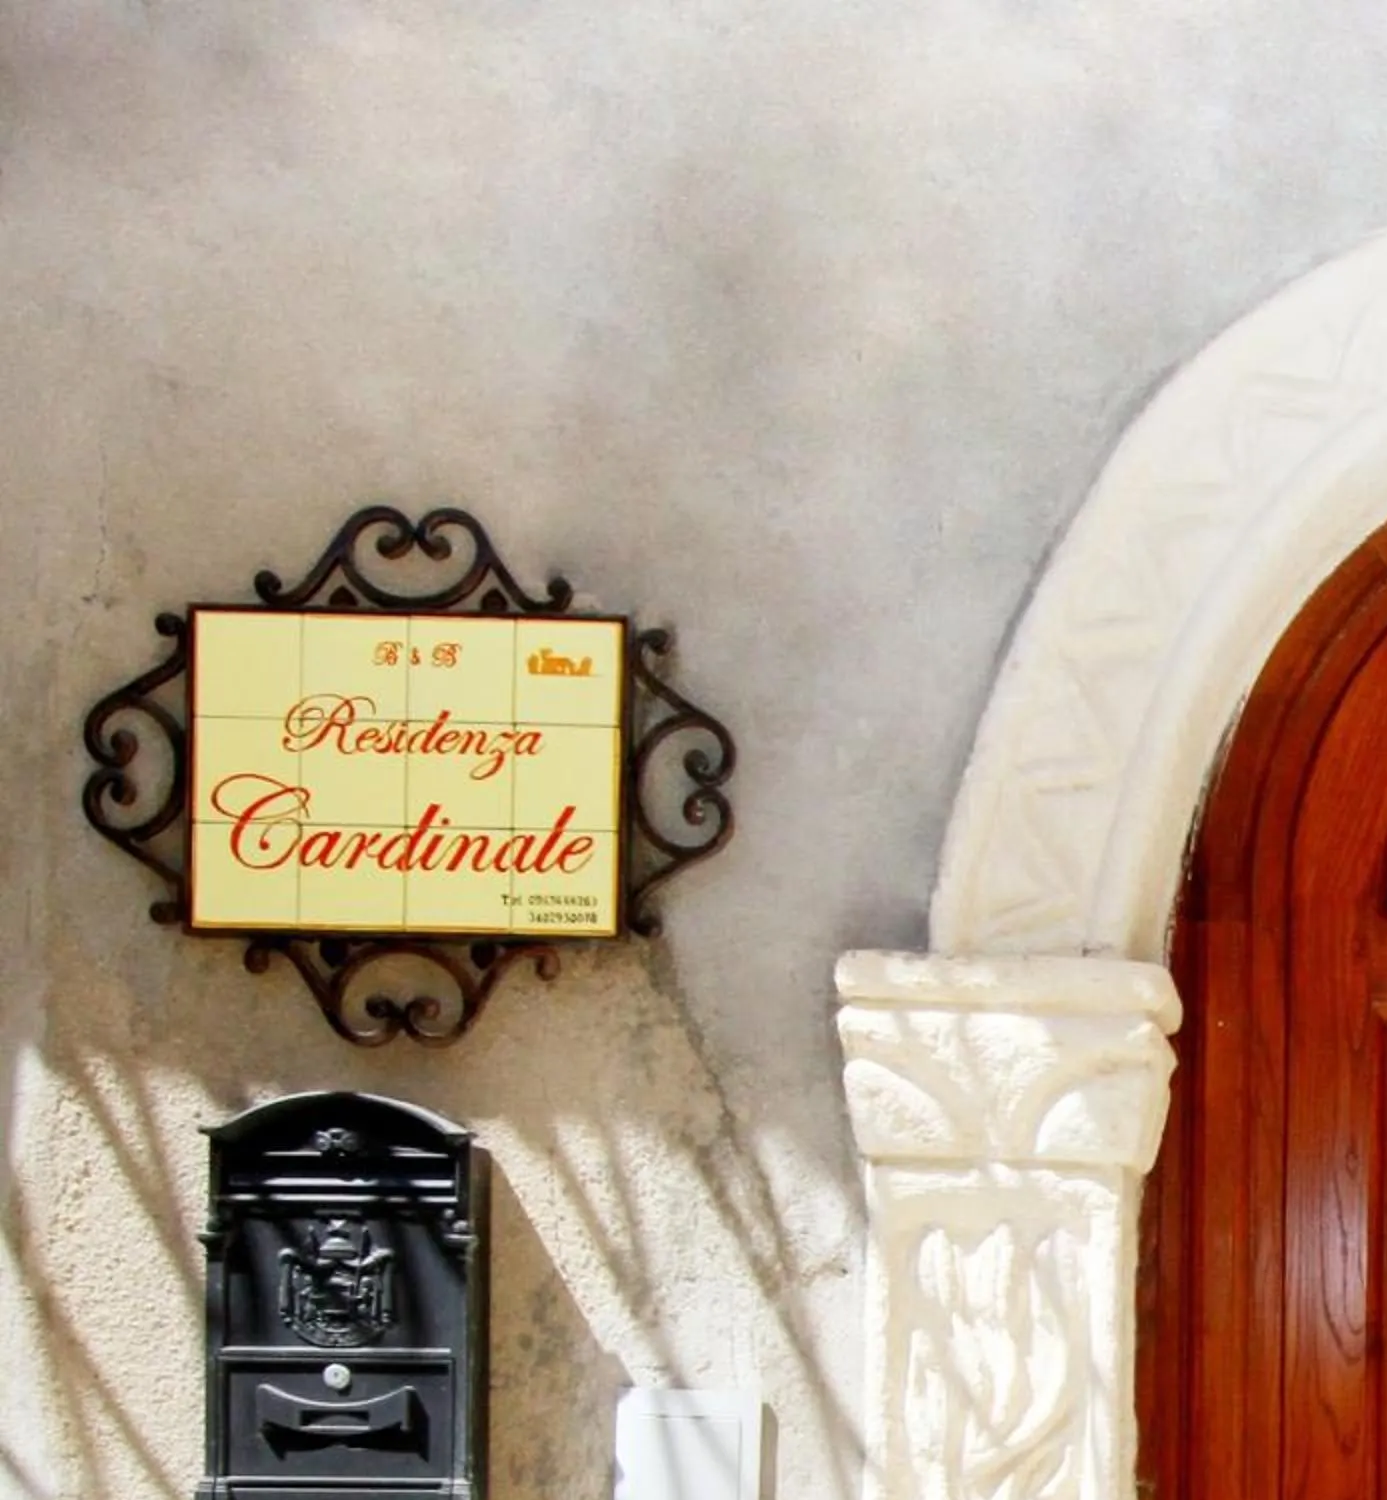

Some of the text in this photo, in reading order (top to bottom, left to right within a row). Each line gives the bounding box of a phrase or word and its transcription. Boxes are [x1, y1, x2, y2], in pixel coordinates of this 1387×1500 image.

[373, 641, 403, 666] B
[431, 642, 462, 667] B
[282, 693, 545, 780] Residenza
[210, 773, 595, 875] Cardinale
